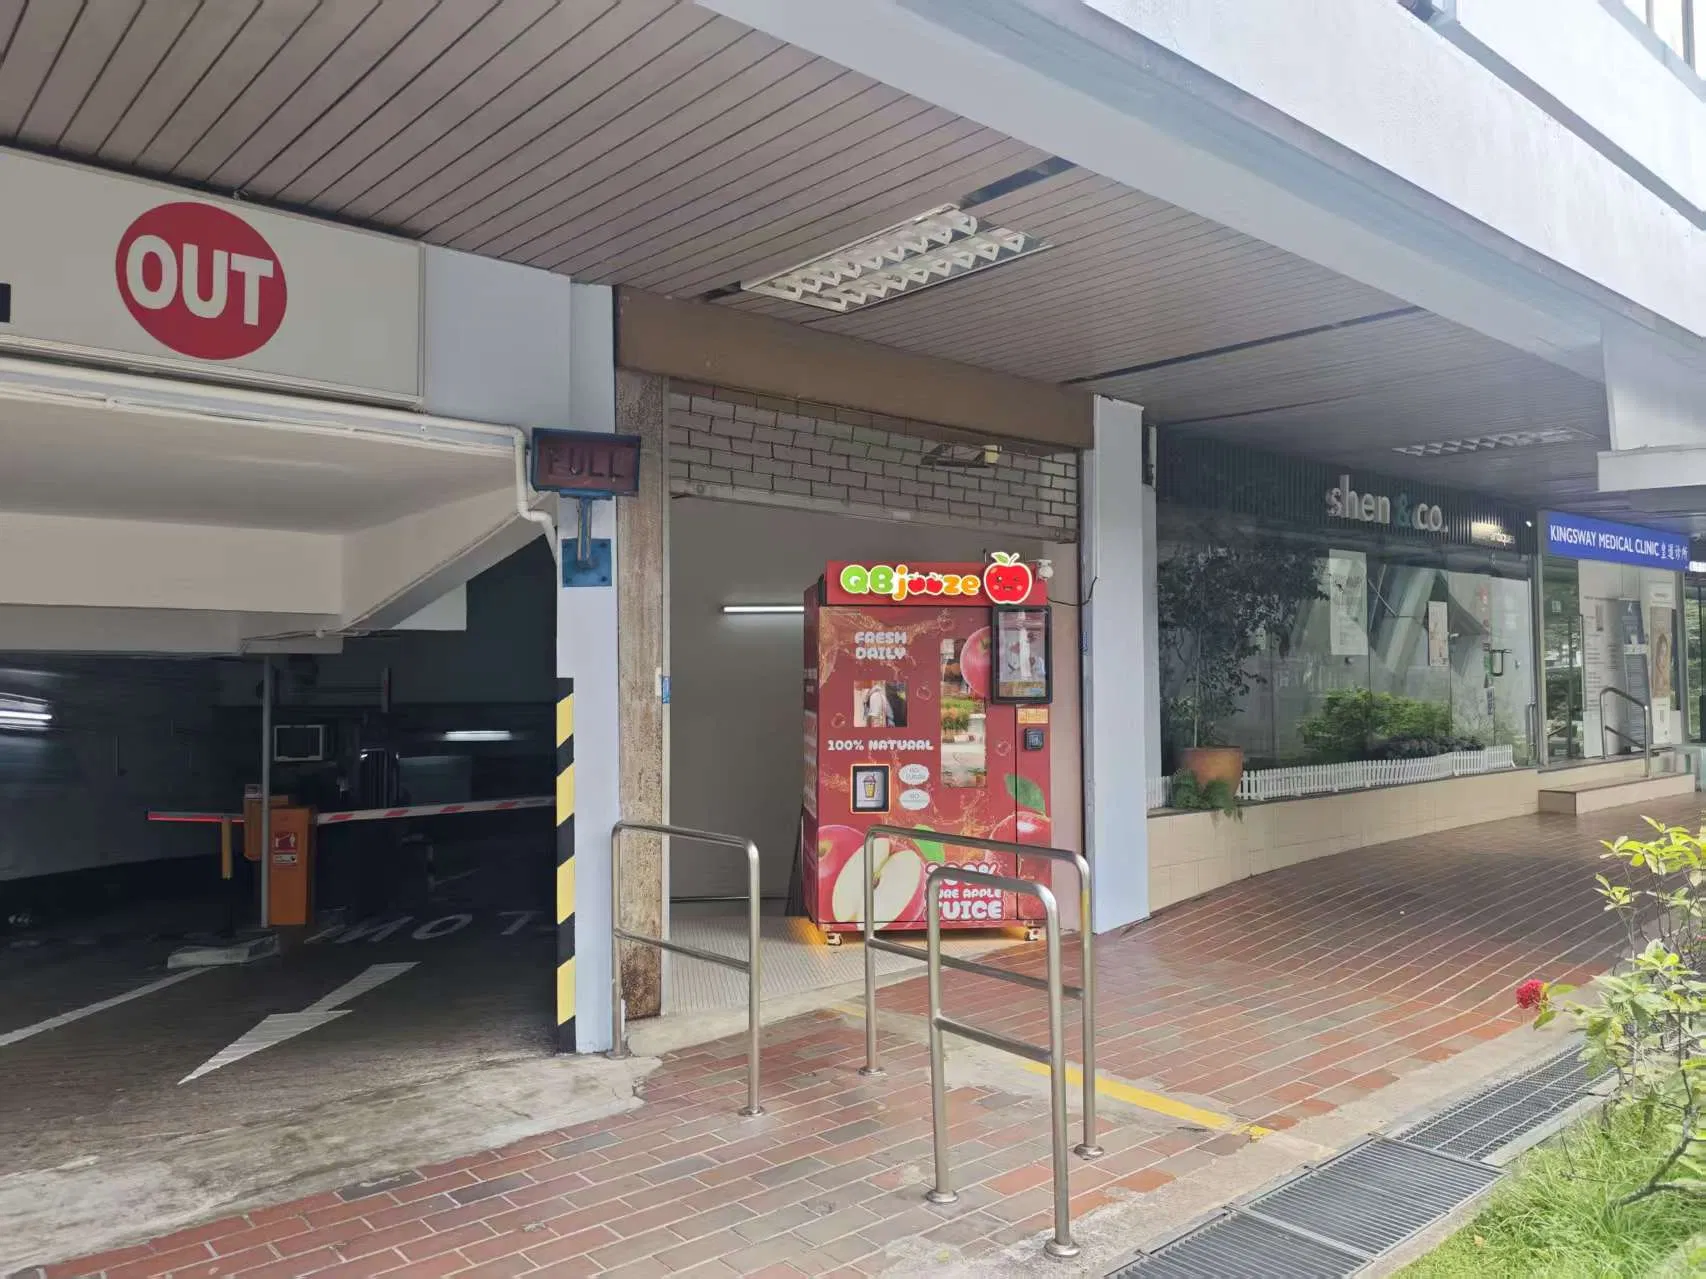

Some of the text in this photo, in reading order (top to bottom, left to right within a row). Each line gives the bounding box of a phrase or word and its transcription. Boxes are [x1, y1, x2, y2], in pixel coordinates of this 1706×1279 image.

[125, 234, 274, 327] OUT
[547, 447, 625, 479] FULL
[1327, 474, 1390, 525] shen
[1550, 524, 1597, 547] KINGSWAY
[1598, 533, 1634, 553] MEDICAL
[1634, 539, 1660, 557] CLINIC
[854, 631, 908, 645] FRESH
[854, 646, 908, 660] DAILY
[827, 738, 934, 752] 100% NATURAL
[963, 888, 1002, 899] APPLE
[938, 900, 1002, 920] UICE
